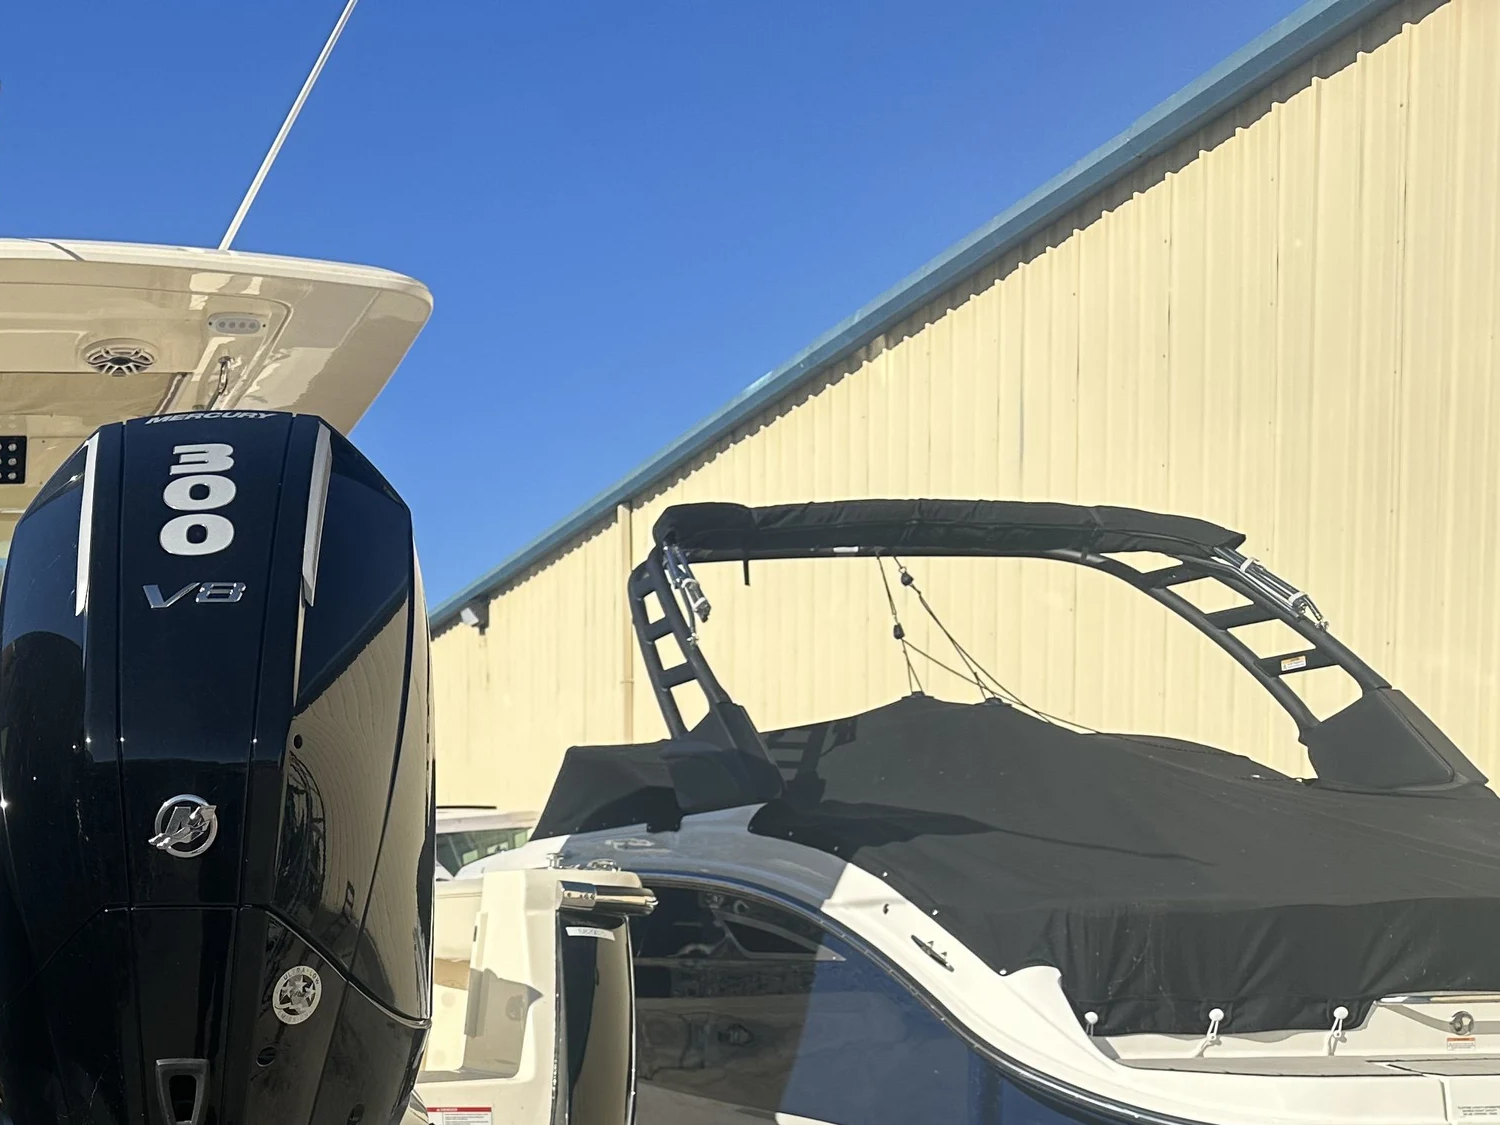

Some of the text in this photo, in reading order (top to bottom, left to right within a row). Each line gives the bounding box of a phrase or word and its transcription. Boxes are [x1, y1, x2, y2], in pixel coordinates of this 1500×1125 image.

[145, 411, 279, 424] MERCURY
[159, 443, 237, 556] 300
[143, 582, 247, 608] V8
